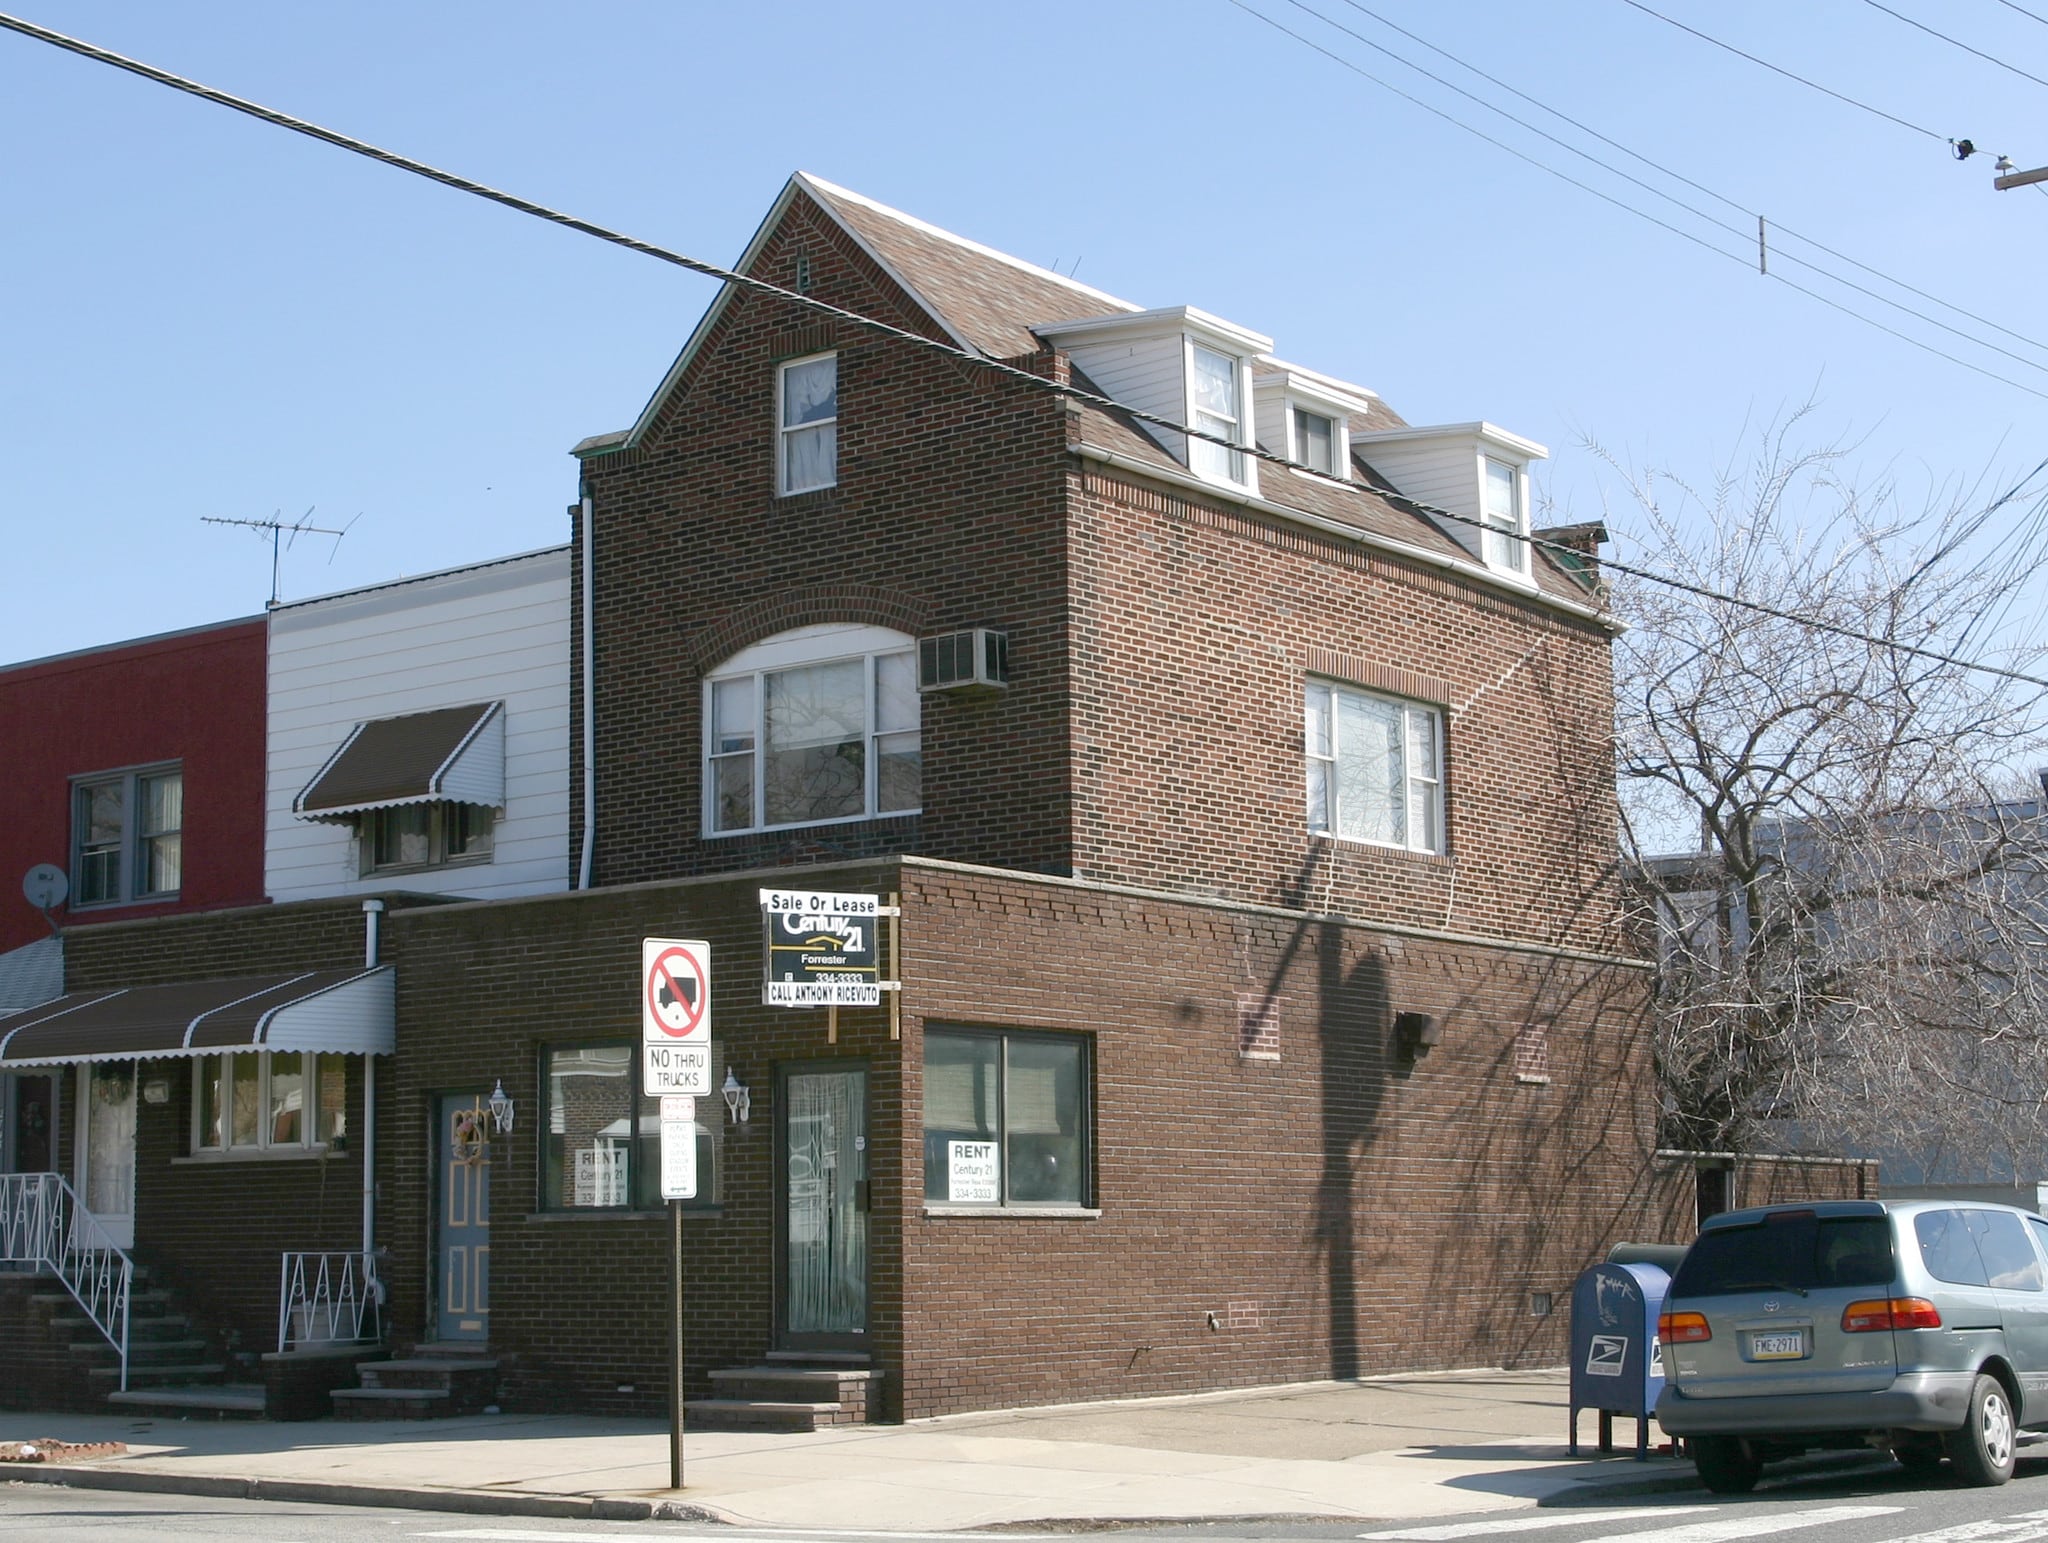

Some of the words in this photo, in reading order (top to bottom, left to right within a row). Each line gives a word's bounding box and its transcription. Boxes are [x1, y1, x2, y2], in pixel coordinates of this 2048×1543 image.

[771, 894, 803, 910] Sale
[810, 896, 826, 911] Or
[833, 897, 875, 913] Lease
[782, 912, 850, 936] Century
[842, 926, 862, 952] 21
[801, 953, 847, 965] Forrester
[815, 972, 864, 984] 334-3333
[771, 985, 793, 1001] CALL
[796, 985, 834, 1001] ANTHONY
[837, 985, 878, 1002] RICEVUTO
[651, 1049, 670, 1068] NO
[674, 1054, 704, 1068] THRU
[657, 1072, 699, 1086] TRUCKS
[954, 1144, 991, 1159] RENT
[953, 1163, 983, 1177] Century
[985, 1164, 993, 1175] 21
